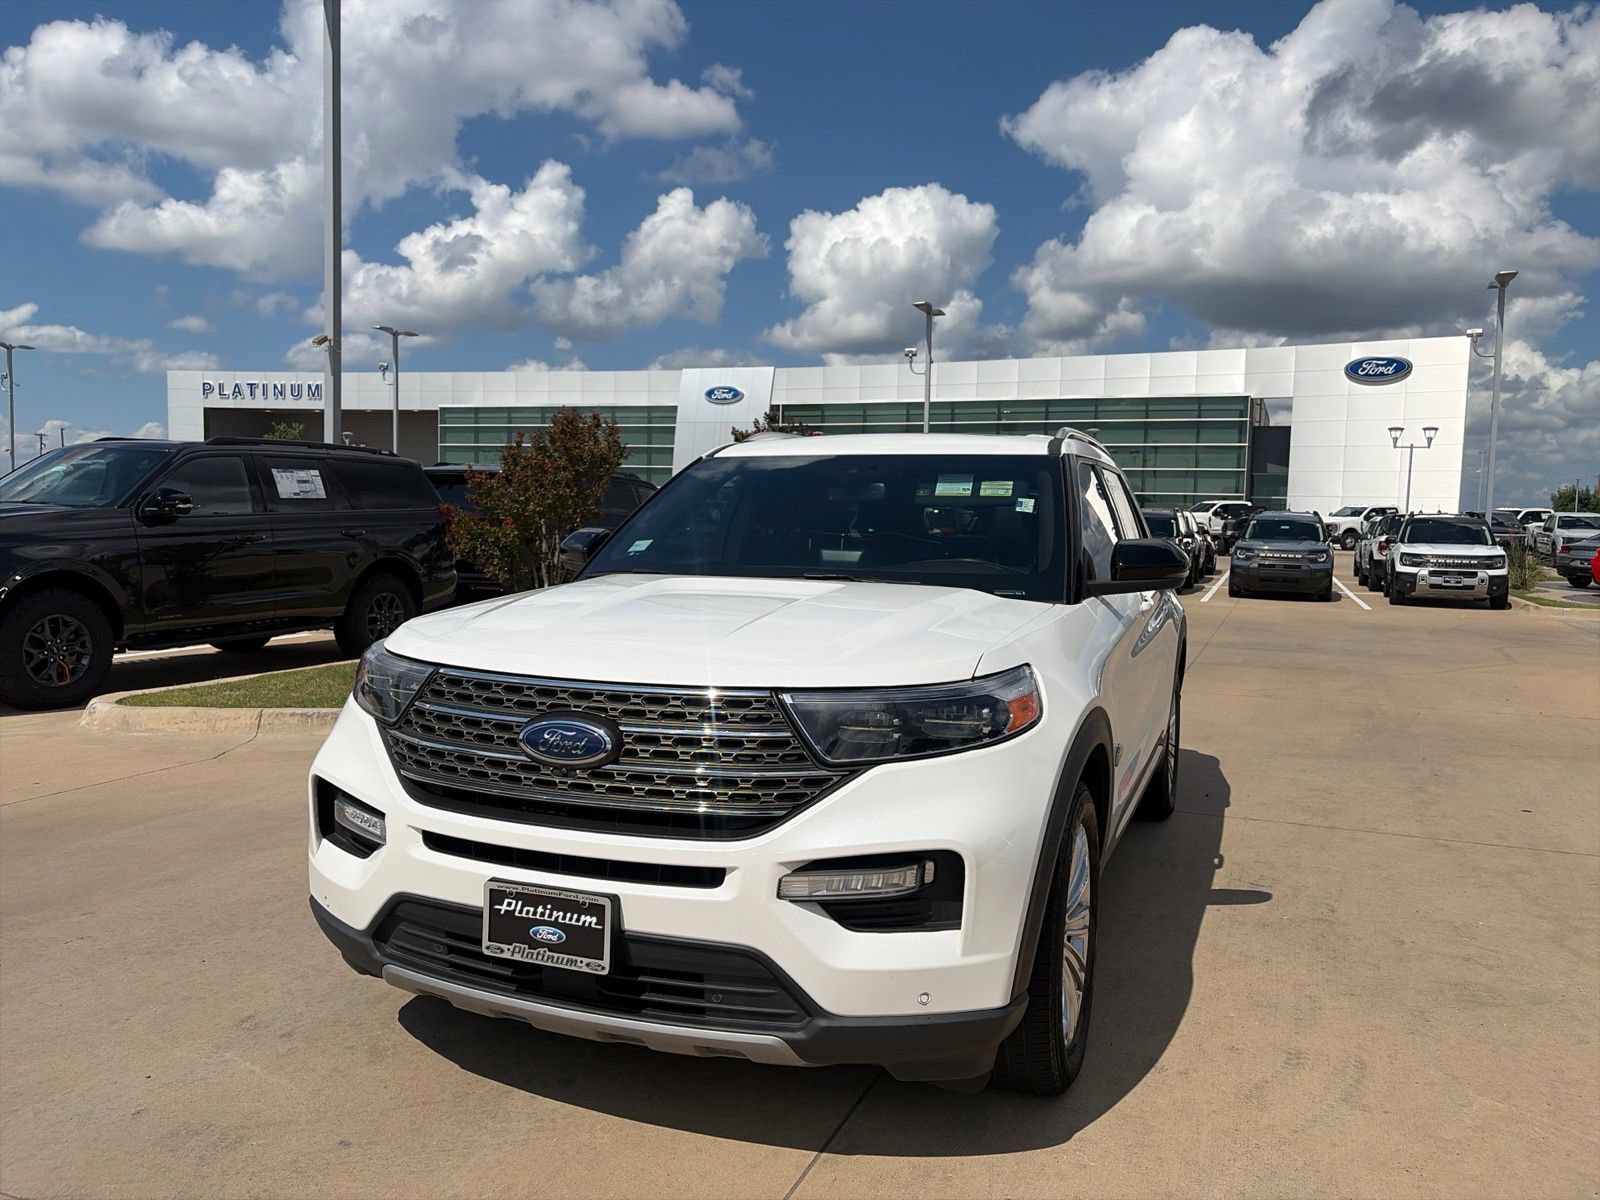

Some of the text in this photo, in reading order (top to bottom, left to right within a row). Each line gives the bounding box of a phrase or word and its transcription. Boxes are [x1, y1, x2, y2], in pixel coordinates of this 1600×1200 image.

[1358, 360, 1397, 375] Ford
[202, 382, 322, 399] PLATINUM
[711, 389, 734, 399] Ford
[539, 728, 588, 754] Ford
[496, 883, 600, 903] www.PlatinumFord.com
[494, 898, 603, 929] Platinum
[537, 929, 559, 941] Ford
[511, 943, 584, 969] Platinum
